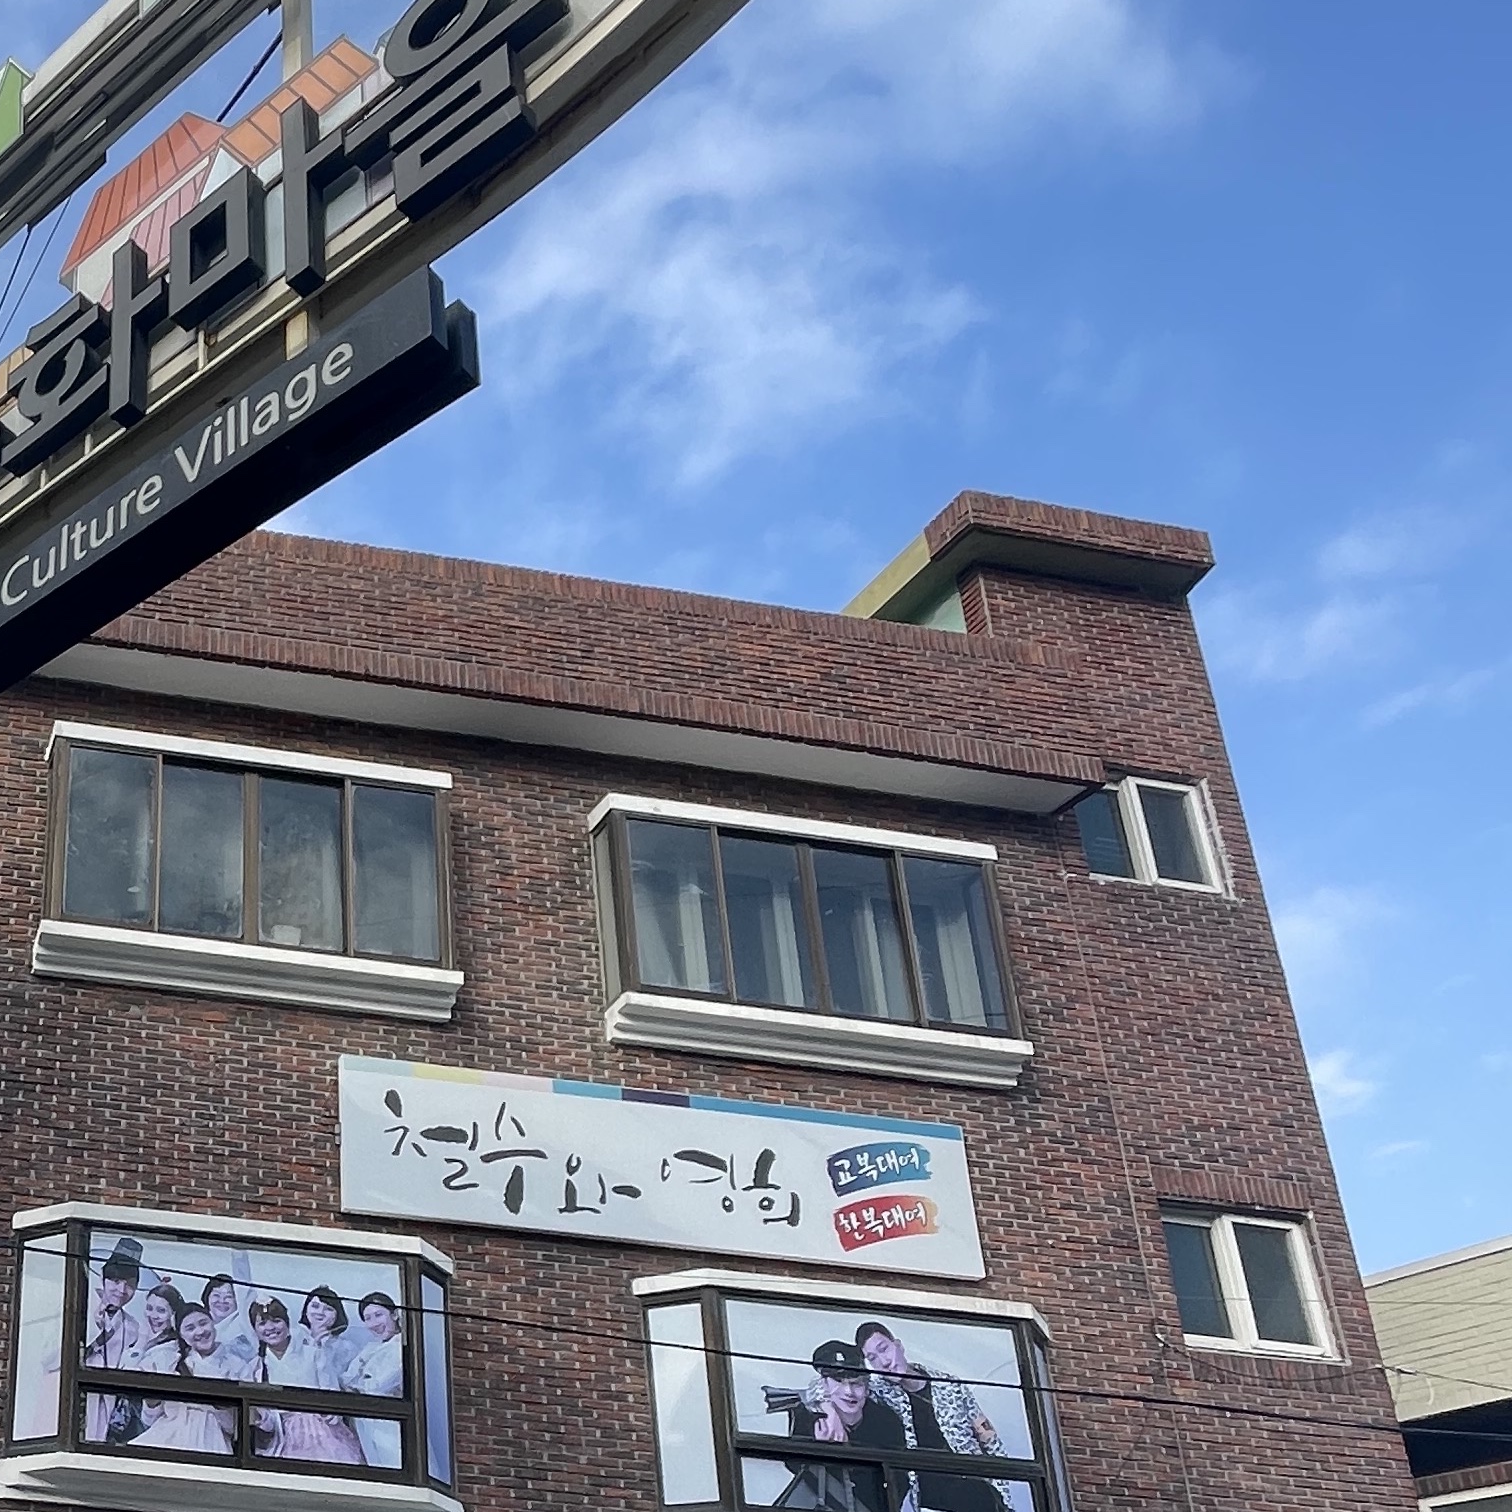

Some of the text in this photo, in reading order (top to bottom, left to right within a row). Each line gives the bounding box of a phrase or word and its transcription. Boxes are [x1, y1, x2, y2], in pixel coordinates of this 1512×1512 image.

[0, 474, 163, 605] Culture
[174, 341, 355, 484] Village
[833, 1147, 921, 1187] 교복대여
[838, 1201, 927, 1241] 한복대여
